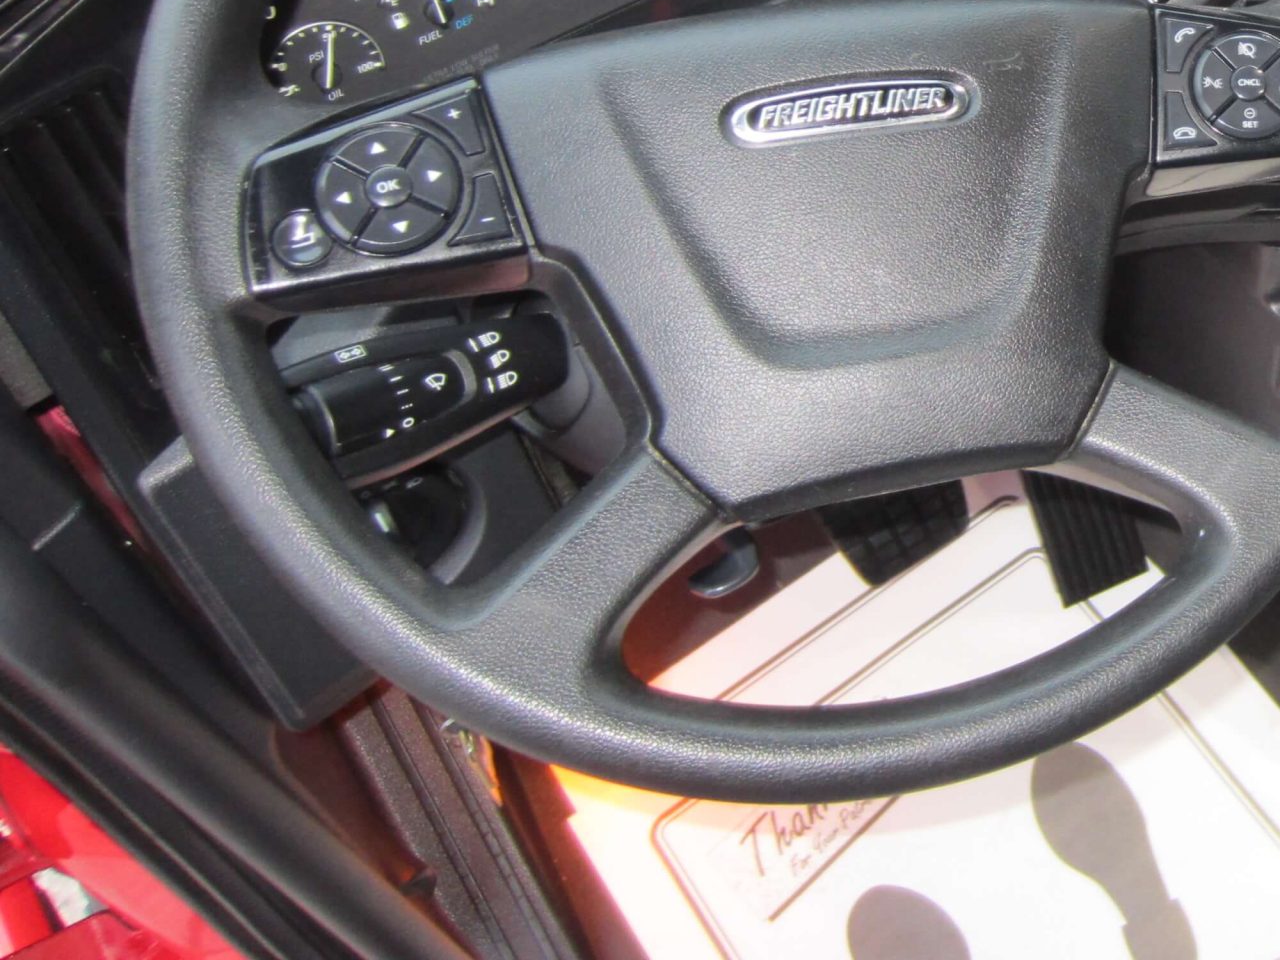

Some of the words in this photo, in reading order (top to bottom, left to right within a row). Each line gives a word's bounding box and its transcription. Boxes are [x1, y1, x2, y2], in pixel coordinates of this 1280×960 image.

[456, 14, 474, 30] DEF
[418, 29, 443, 46] FUEL
[308, 51, 324, 64] PSI
[357, 61, 375, 73] 100
[1238, 78, 1261, 87] CNCL
[328, 88, 345, 101] OIL
[757, 86, 947, 129] FREIGHTLINER
[1242, 120, 1259, 128] SET
[376, 179, 400, 194] OK
